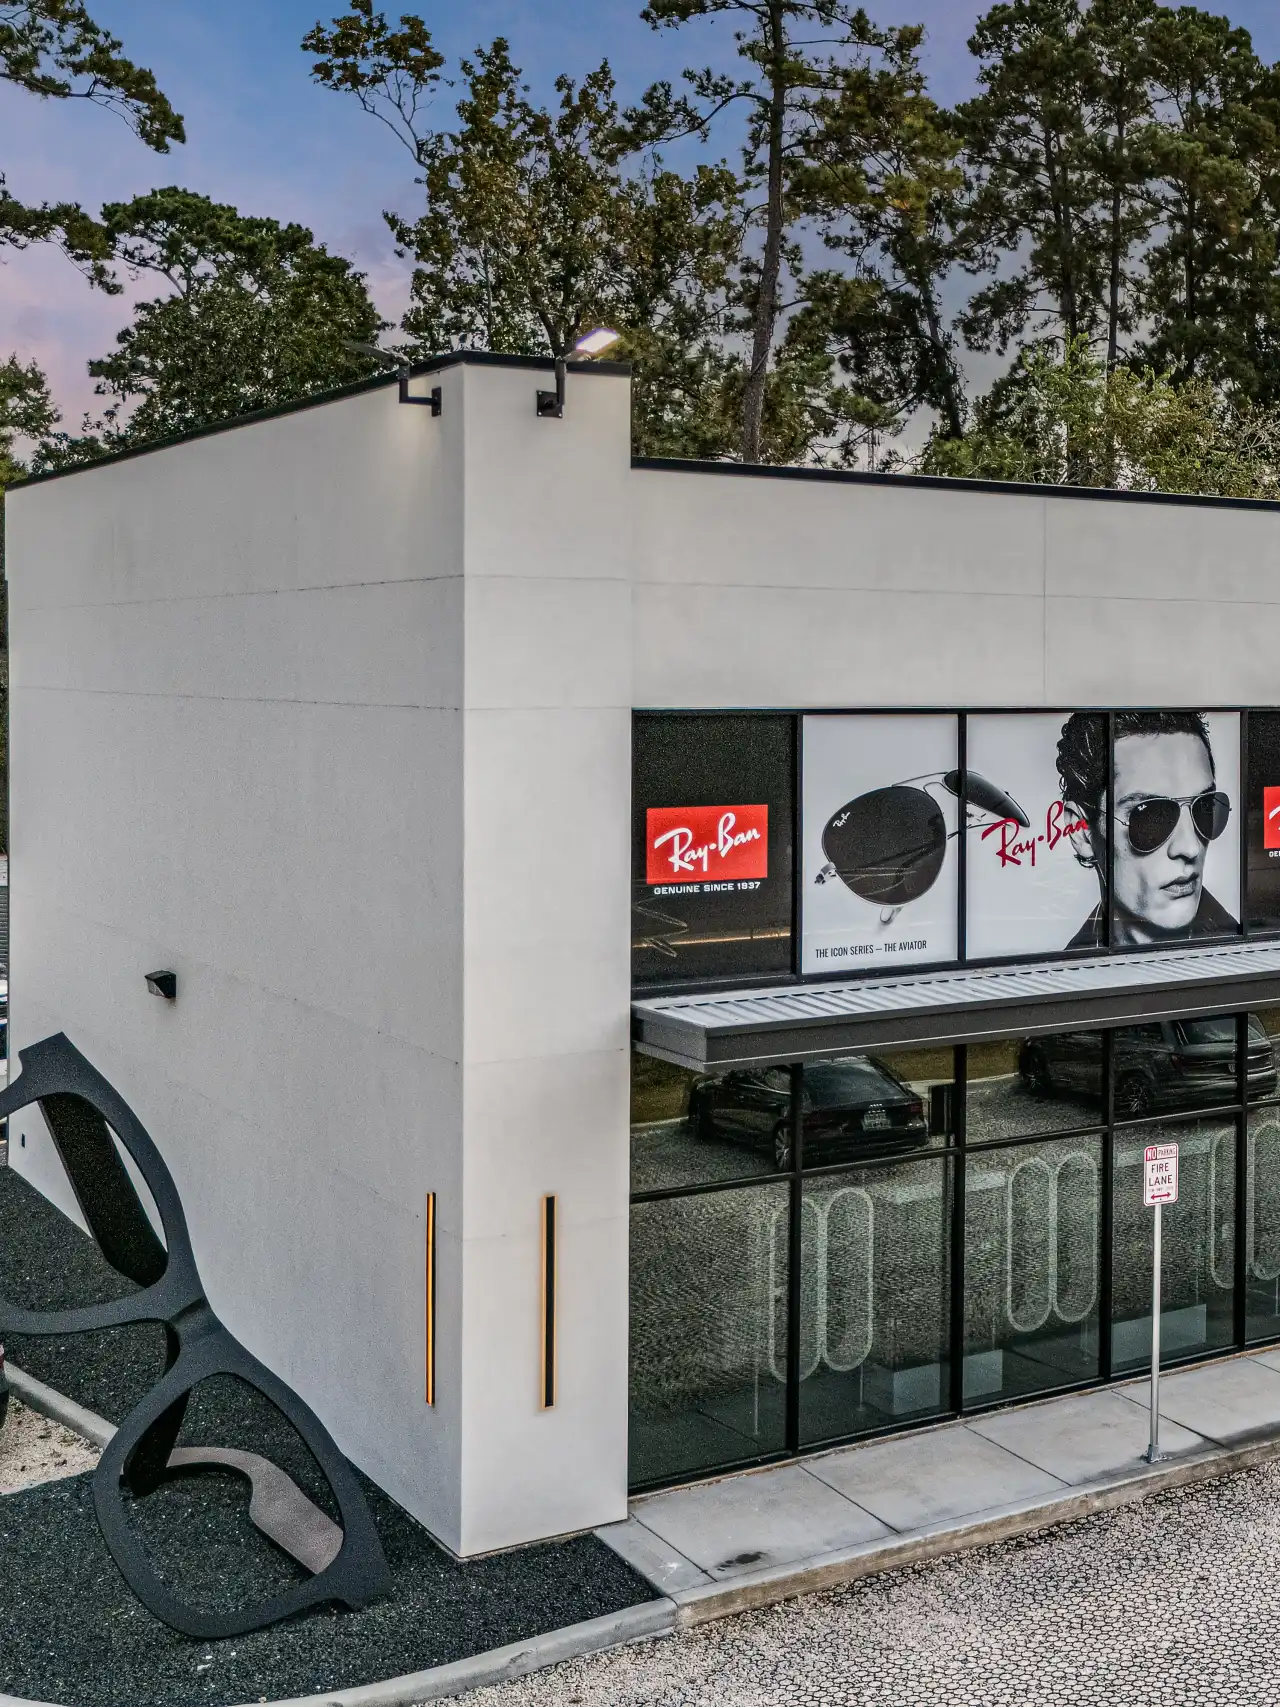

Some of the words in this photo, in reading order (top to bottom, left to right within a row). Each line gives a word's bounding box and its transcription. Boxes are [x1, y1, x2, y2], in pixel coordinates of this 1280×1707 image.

[654, 885, 700, 895] GENUINE
[703, 883, 735, 892] SINCE
[737, 881, 761, 890] 1937
[815, 948, 829, 959] THE
[830, 946, 848, 957] ICON
[850, 944, 874, 956] SERIES
[884, 942, 897, 953] THE
[898, 940, 927, 951] AVIATOR
[1146, 1148, 1157, 1160] NO
[1158, 1147, 1176, 1157] PARKING
[1151, 1162, 1169, 1173] FIRE
[1149, 1174, 1172, 1186] LANE
